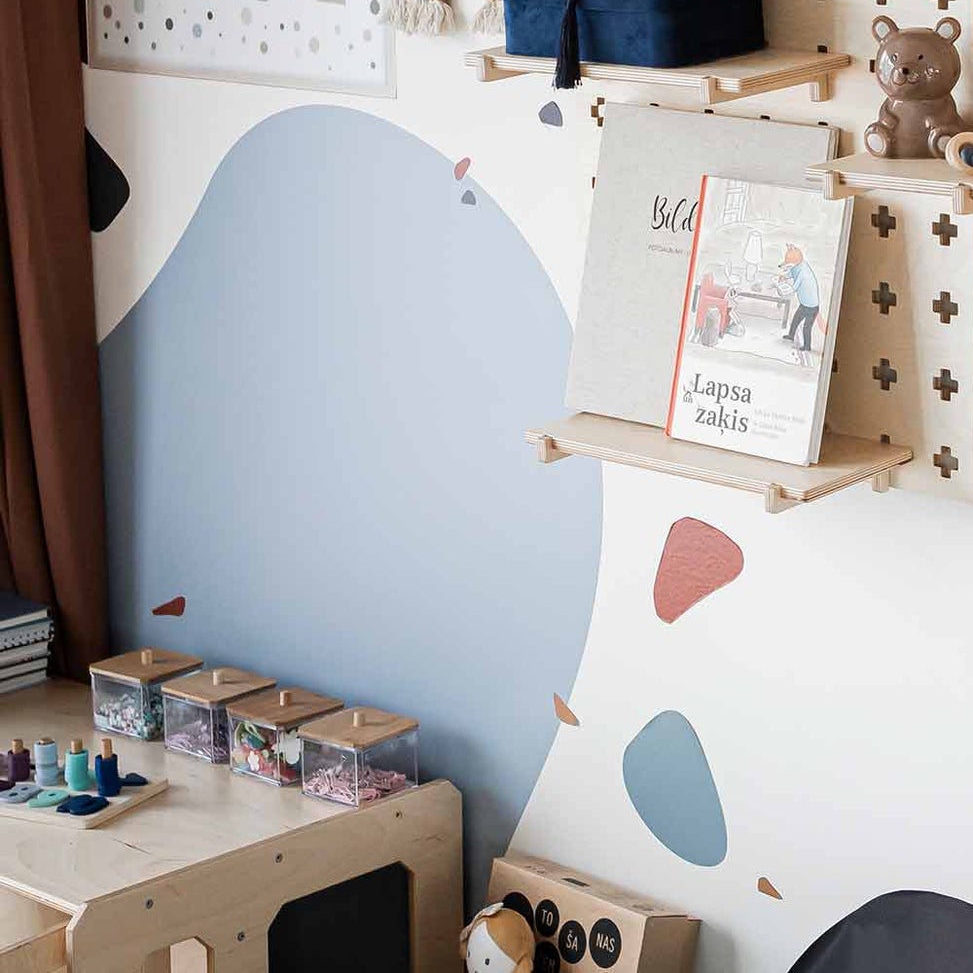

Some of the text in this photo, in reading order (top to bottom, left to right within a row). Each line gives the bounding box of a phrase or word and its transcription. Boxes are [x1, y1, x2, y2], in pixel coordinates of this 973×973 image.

[693, 373, 752, 404] Lapsa
[694, 406, 750, 436] zaķis
[541, 908, 616, 954] TO ŠA NAS
